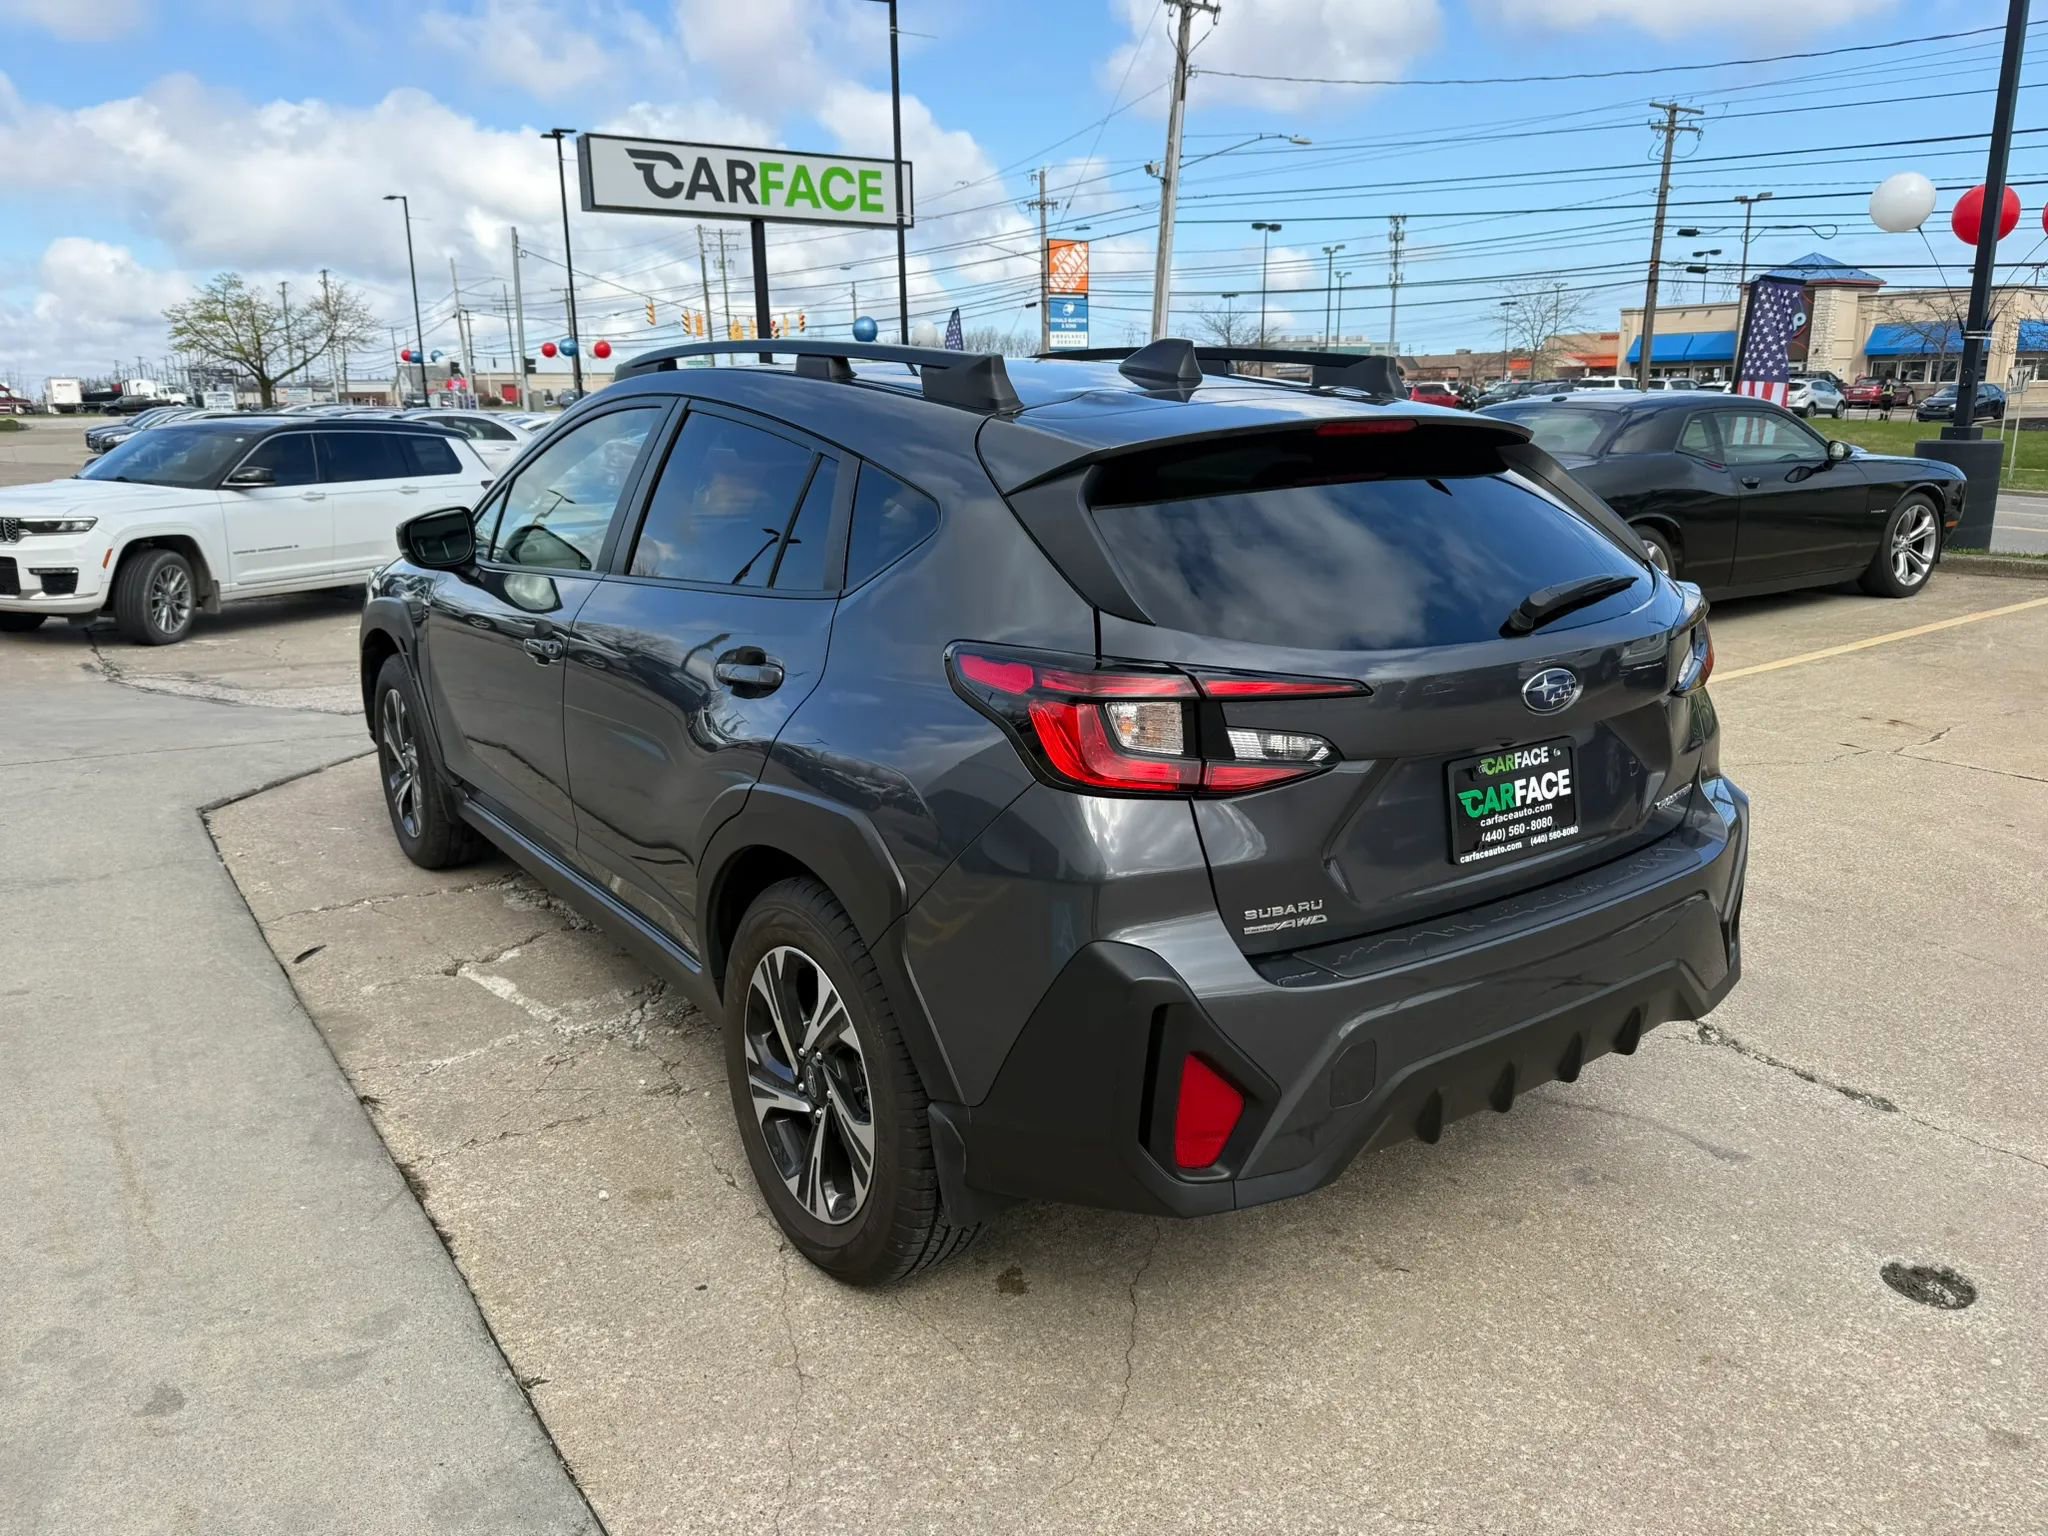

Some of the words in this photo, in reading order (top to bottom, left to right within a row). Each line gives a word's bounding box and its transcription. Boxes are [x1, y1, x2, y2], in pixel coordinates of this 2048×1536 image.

[625, 148, 884, 213] CARFACE
[1480, 746, 1549, 776] CARFACE
[1457, 768, 1572, 818] CARFACE
[1480, 802, 1553, 827] carfaceauto.com
[1460, 840, 1523, 864] carfaceauto.com
[1530, 833, 1548, 847] (440)
[1549, 825, 1579, 841] 560-8080
[1481, 828, 1506, 843] (440)
[1244, 899, 1323, 920] SUBARU
[1276, 914, 1328, 931] AWD
